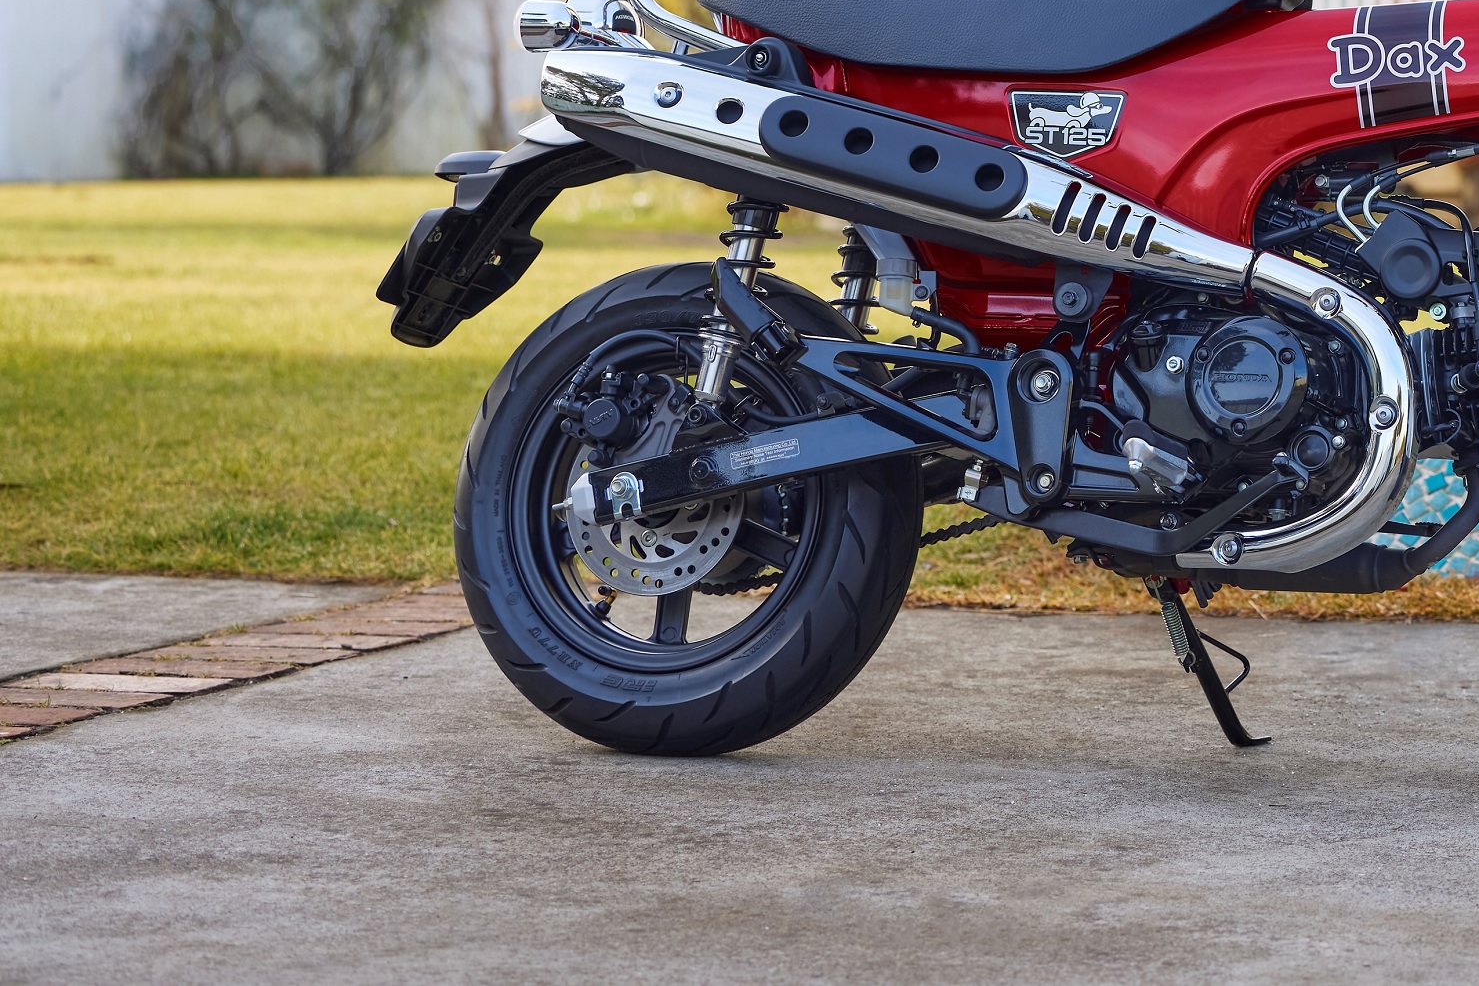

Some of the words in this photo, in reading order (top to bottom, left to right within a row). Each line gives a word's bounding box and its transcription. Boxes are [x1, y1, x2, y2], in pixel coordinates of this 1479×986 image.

[1327, 33, 1466, 88] Dax
[635, 310, 700, 326] 130/7
[1211, 371, 1273, 383] HONDA
[528, 626, 583, 671] NR77U
[600, 674, 658, 693] IRC
